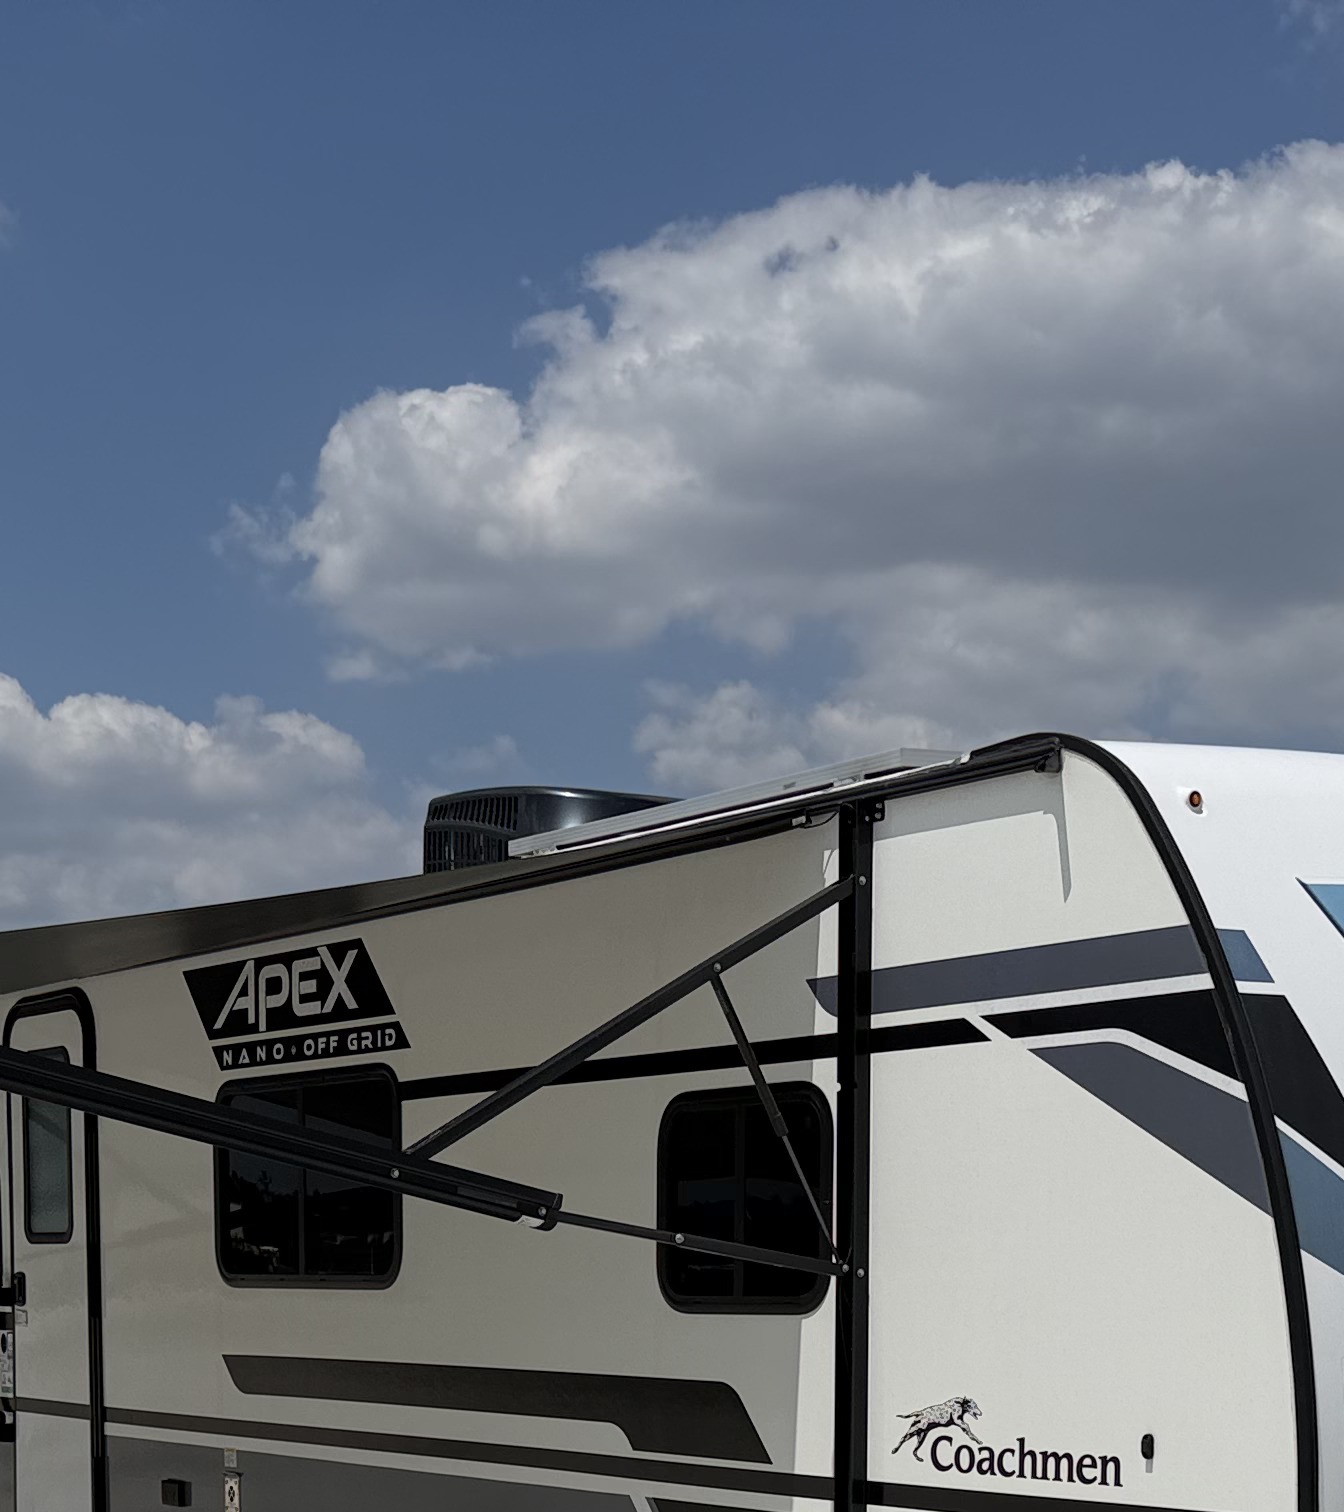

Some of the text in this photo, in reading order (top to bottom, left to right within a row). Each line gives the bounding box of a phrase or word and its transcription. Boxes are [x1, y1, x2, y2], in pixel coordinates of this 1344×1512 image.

[212, 946, 359, 1032] APEX
[222, 1028, 397, 1067] NANO OFF GRID
[929, 1436, 1124, 1488] Coachmen
